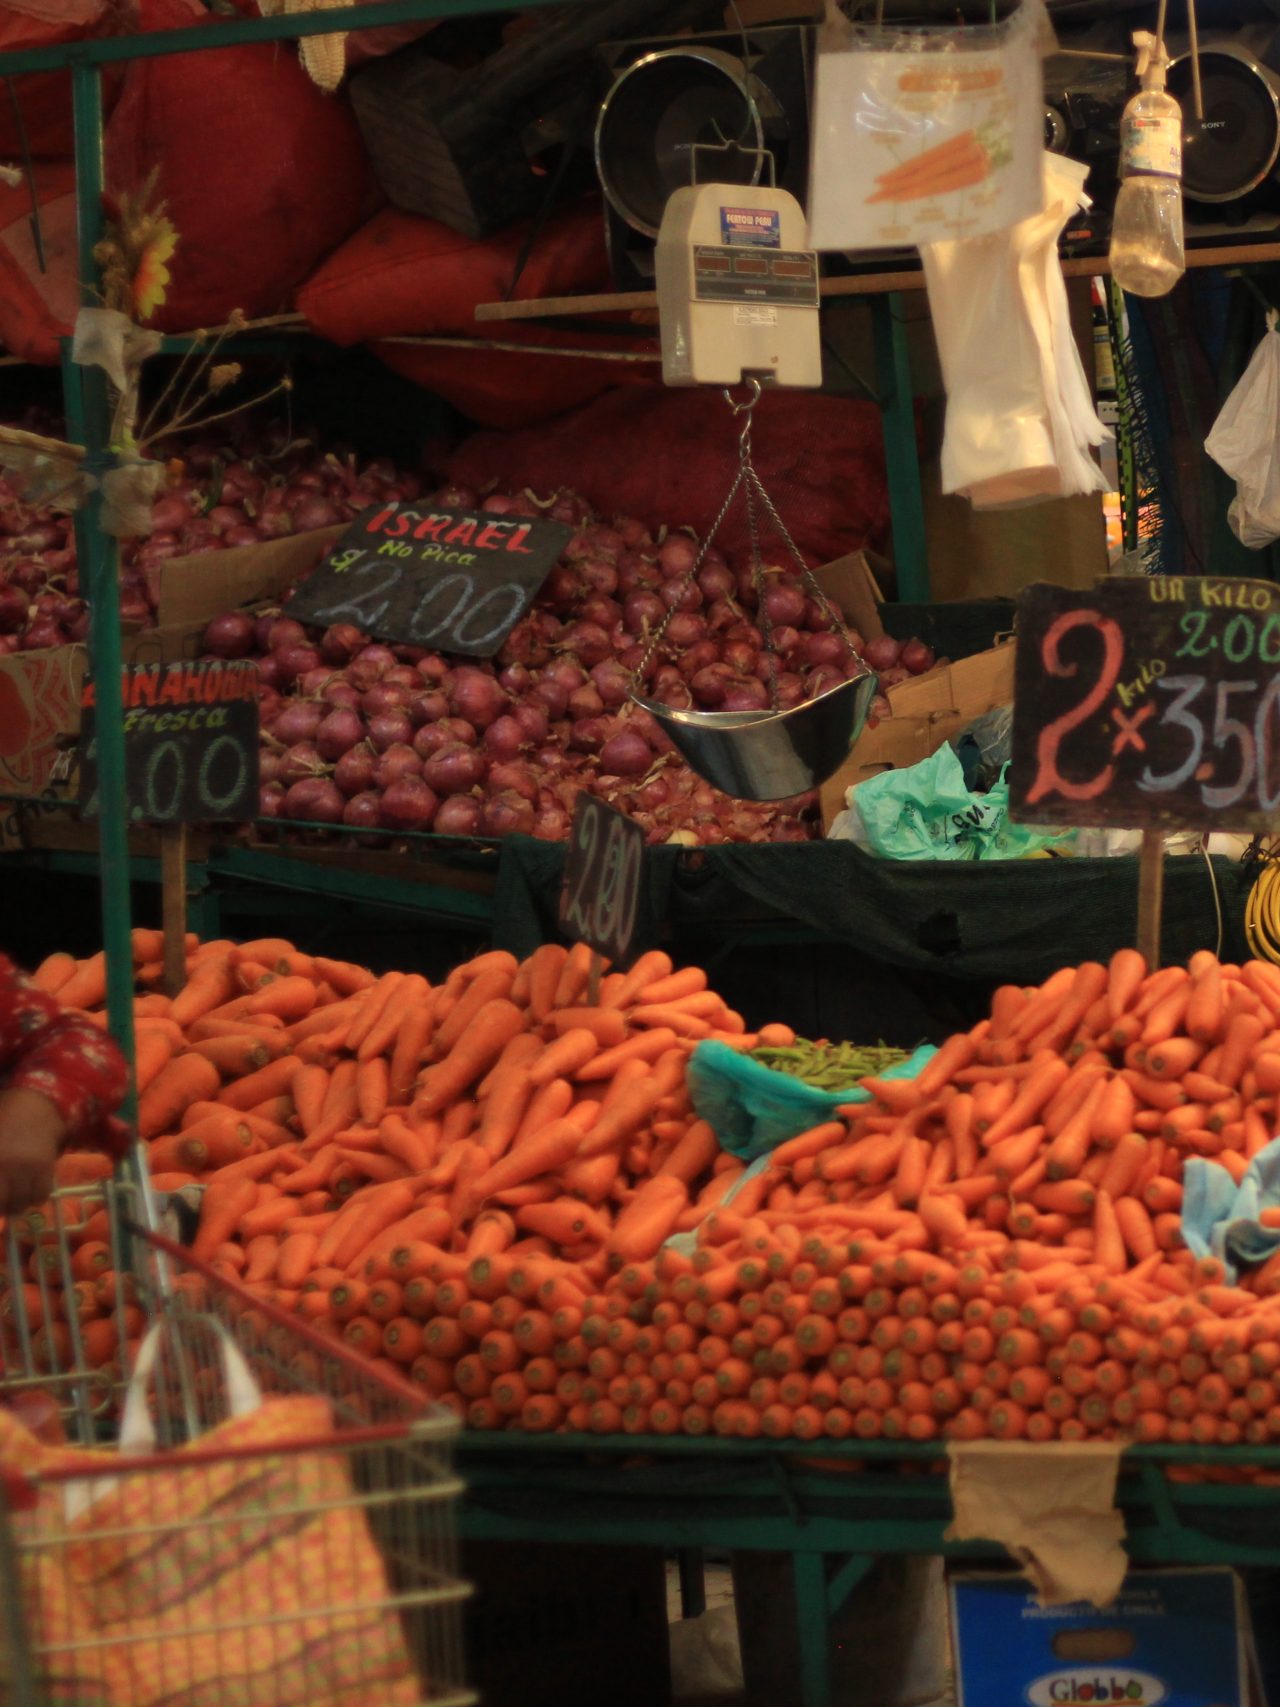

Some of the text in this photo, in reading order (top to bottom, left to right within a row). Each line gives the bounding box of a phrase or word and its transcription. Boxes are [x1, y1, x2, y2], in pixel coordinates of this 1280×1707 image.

[1201, 121, 1226, 129] SONY
[366, 501, 534, 555] ISRAEL
[377, 539, 478, 566] No Pica
[1201, 580, 1272, 610] KILO
[123, 706, 231, 734] Fresca
[1026, 609, 1125, 804] 2
